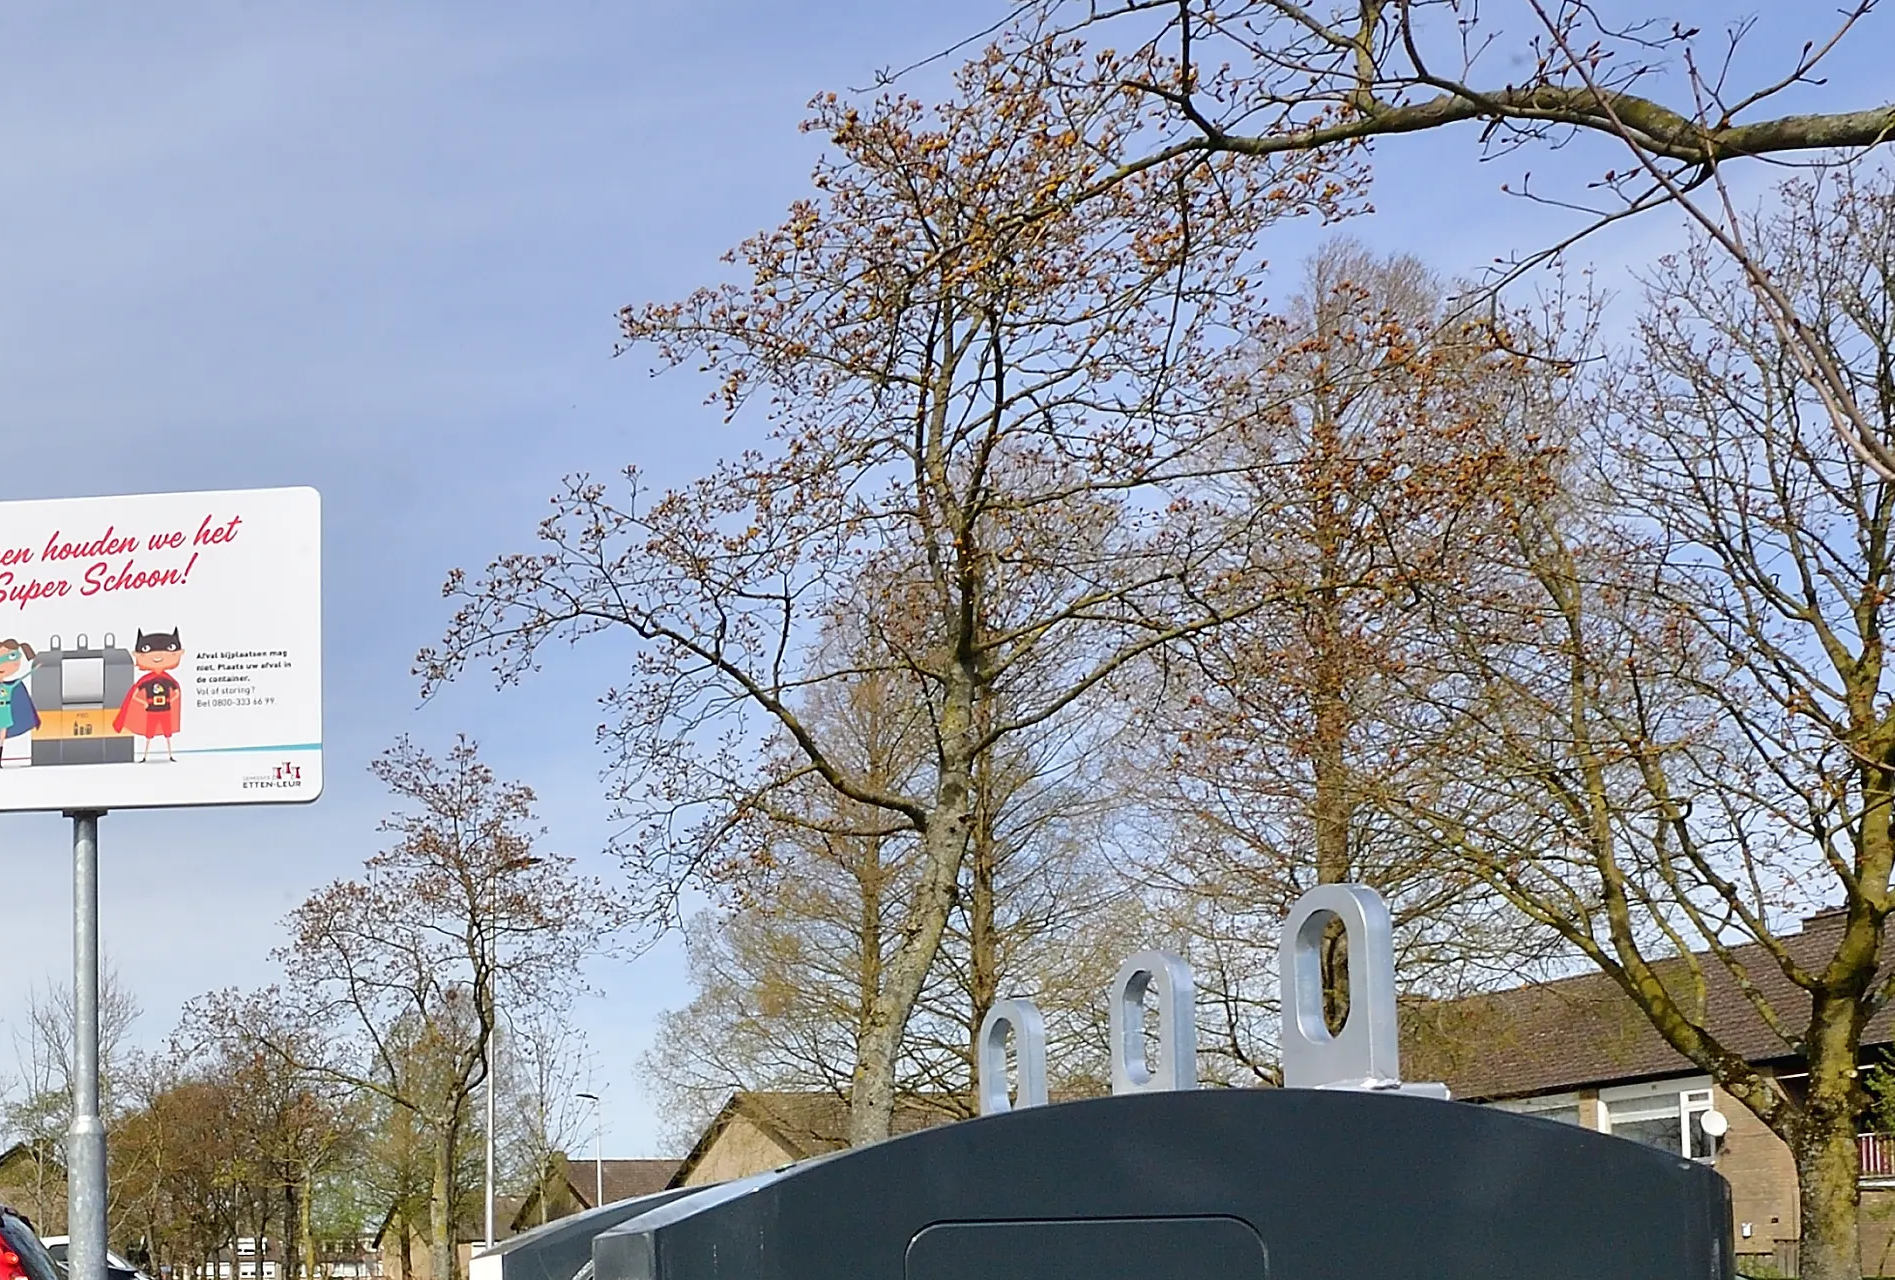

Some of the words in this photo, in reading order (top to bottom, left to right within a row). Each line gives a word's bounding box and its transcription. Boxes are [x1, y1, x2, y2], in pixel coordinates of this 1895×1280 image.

[41, 526, 140, 562] houden
[148, 530, 186, 551] we
[193, 514, 242, 547] het
[80, 552, 199, 596] Schoon!
[196, 652, 218, 660] Afval
[220, 651, 267, 660] bijplaatsen
[217, 663, 244, 671] Plaats
[261, 661, 282, 669] afval
[196, 676, 207, 684] de
[209, 675, 251, 683] container.
[196, 687, 209, 695] Vol
[211, 687, 220, 695] of
[196, 699, 211, 708] Bel
[242, 780, 302, 789] ETTEN-LEUR
